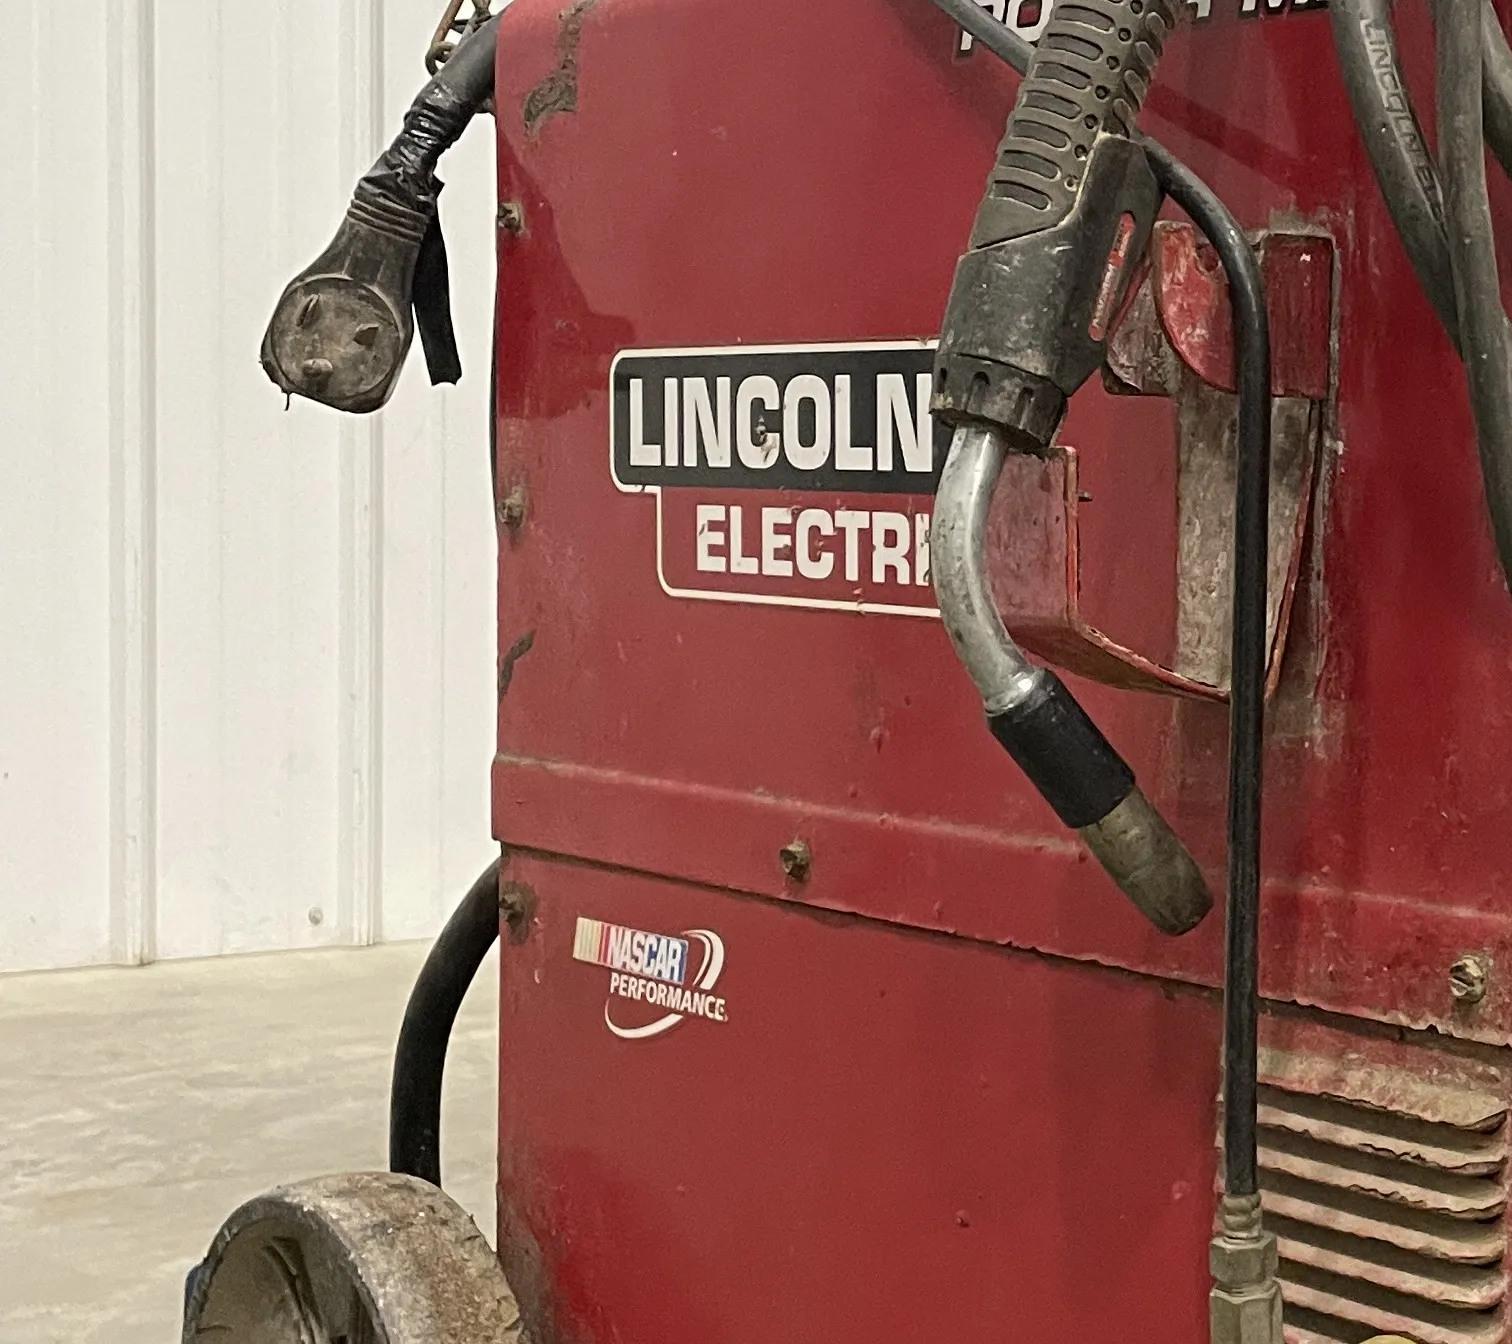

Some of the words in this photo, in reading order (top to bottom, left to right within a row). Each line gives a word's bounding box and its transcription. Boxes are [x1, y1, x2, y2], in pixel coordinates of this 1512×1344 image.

[629, 373, 933, 473] LINCOLN
[696, 504, 930, 587] ELECTRI
[608, 926, 682, 983] NASCAR
[610, 972, 726, 1020] PERFORMANCE
